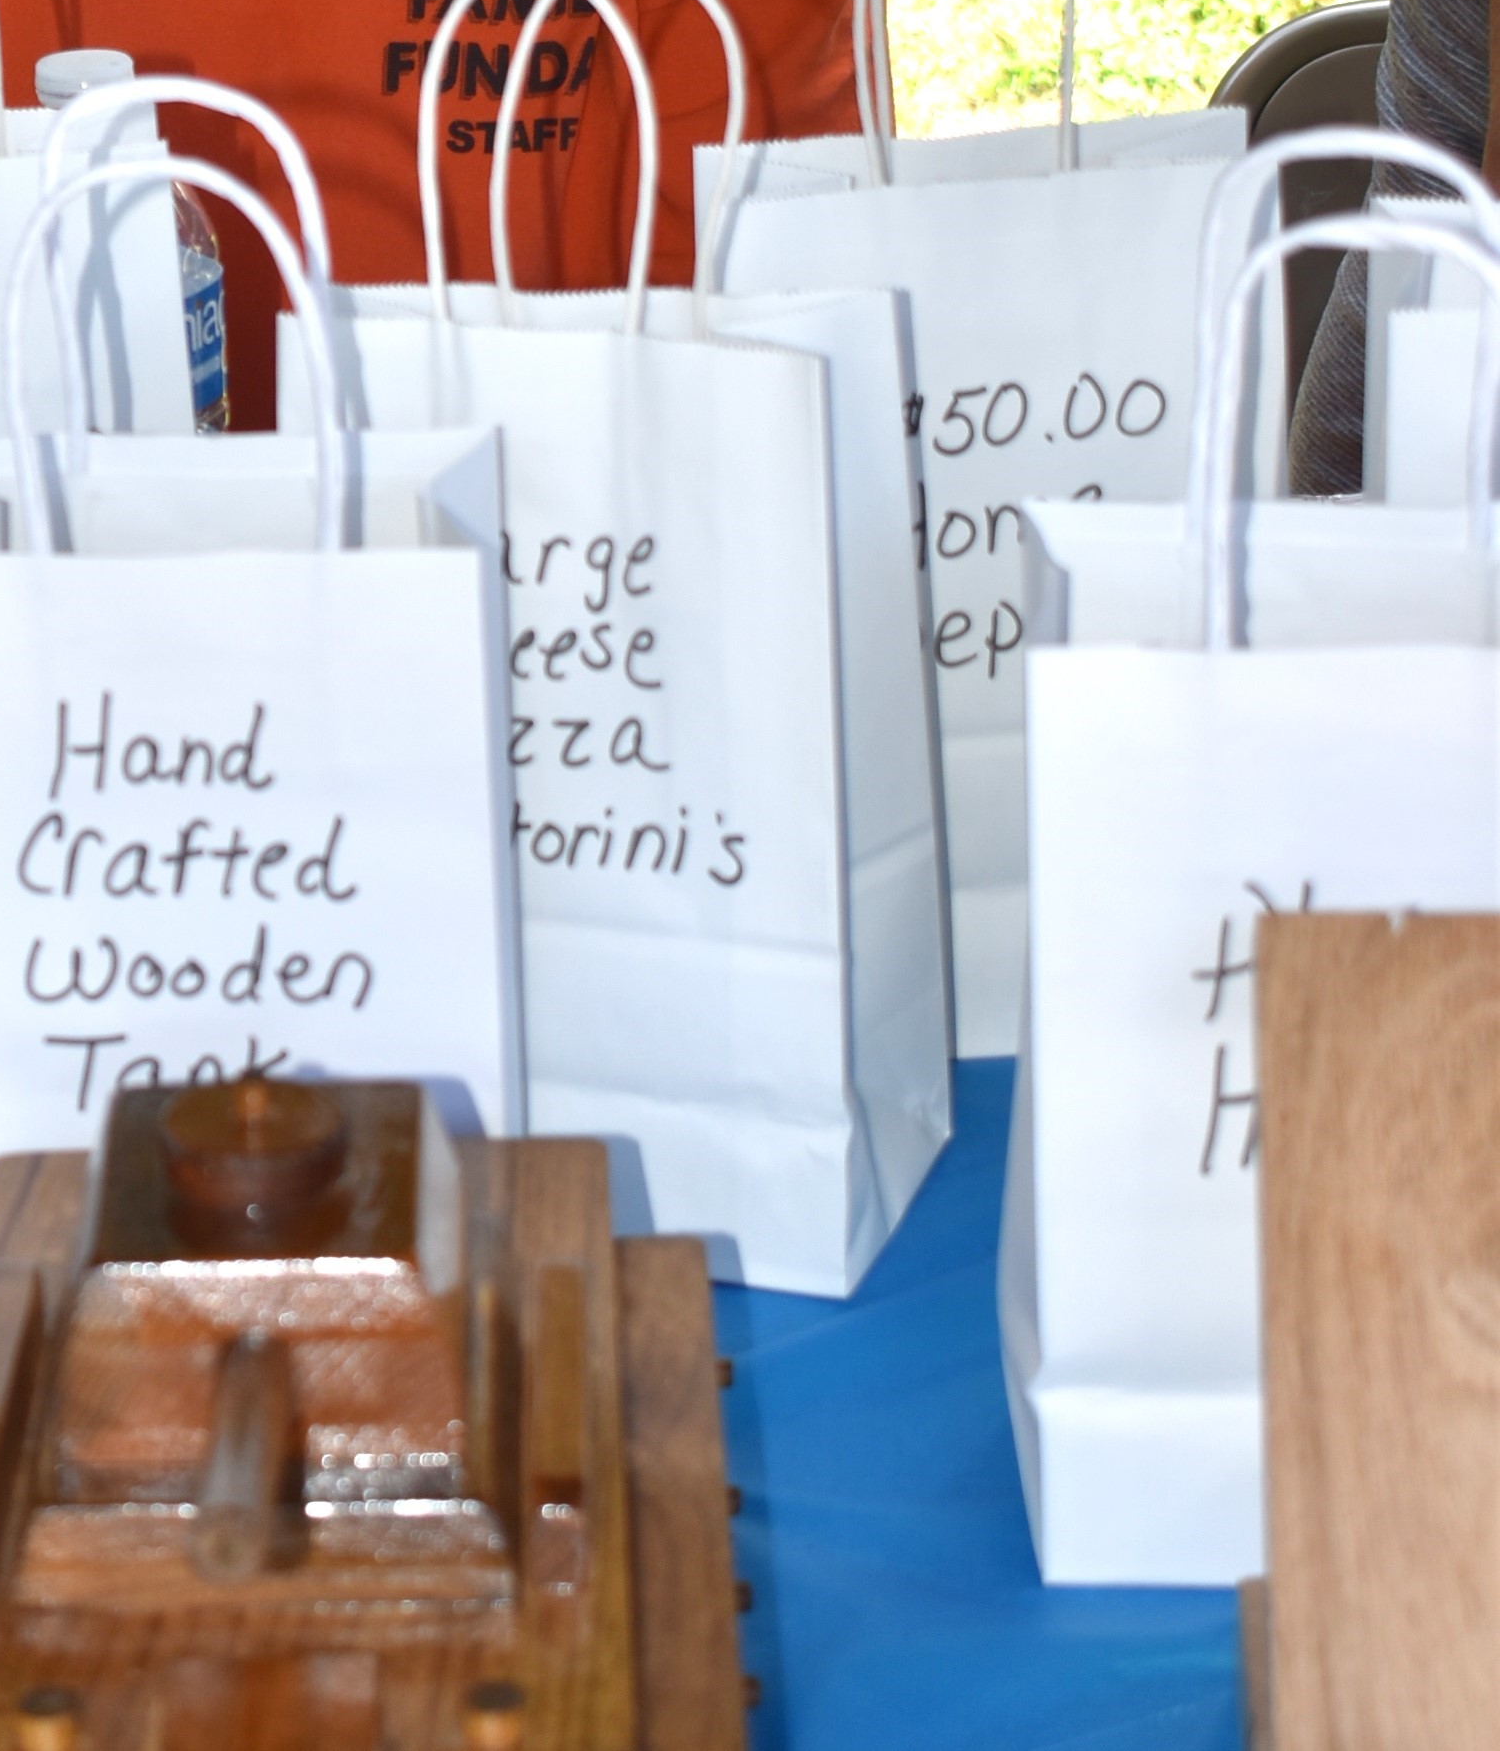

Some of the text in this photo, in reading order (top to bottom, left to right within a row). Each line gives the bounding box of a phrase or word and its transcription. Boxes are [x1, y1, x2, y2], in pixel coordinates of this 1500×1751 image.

[446, 117, 580, 154] STAFF
[48, 689, 275, 802] Hand
[15, 811, 360, 904] Crafted
